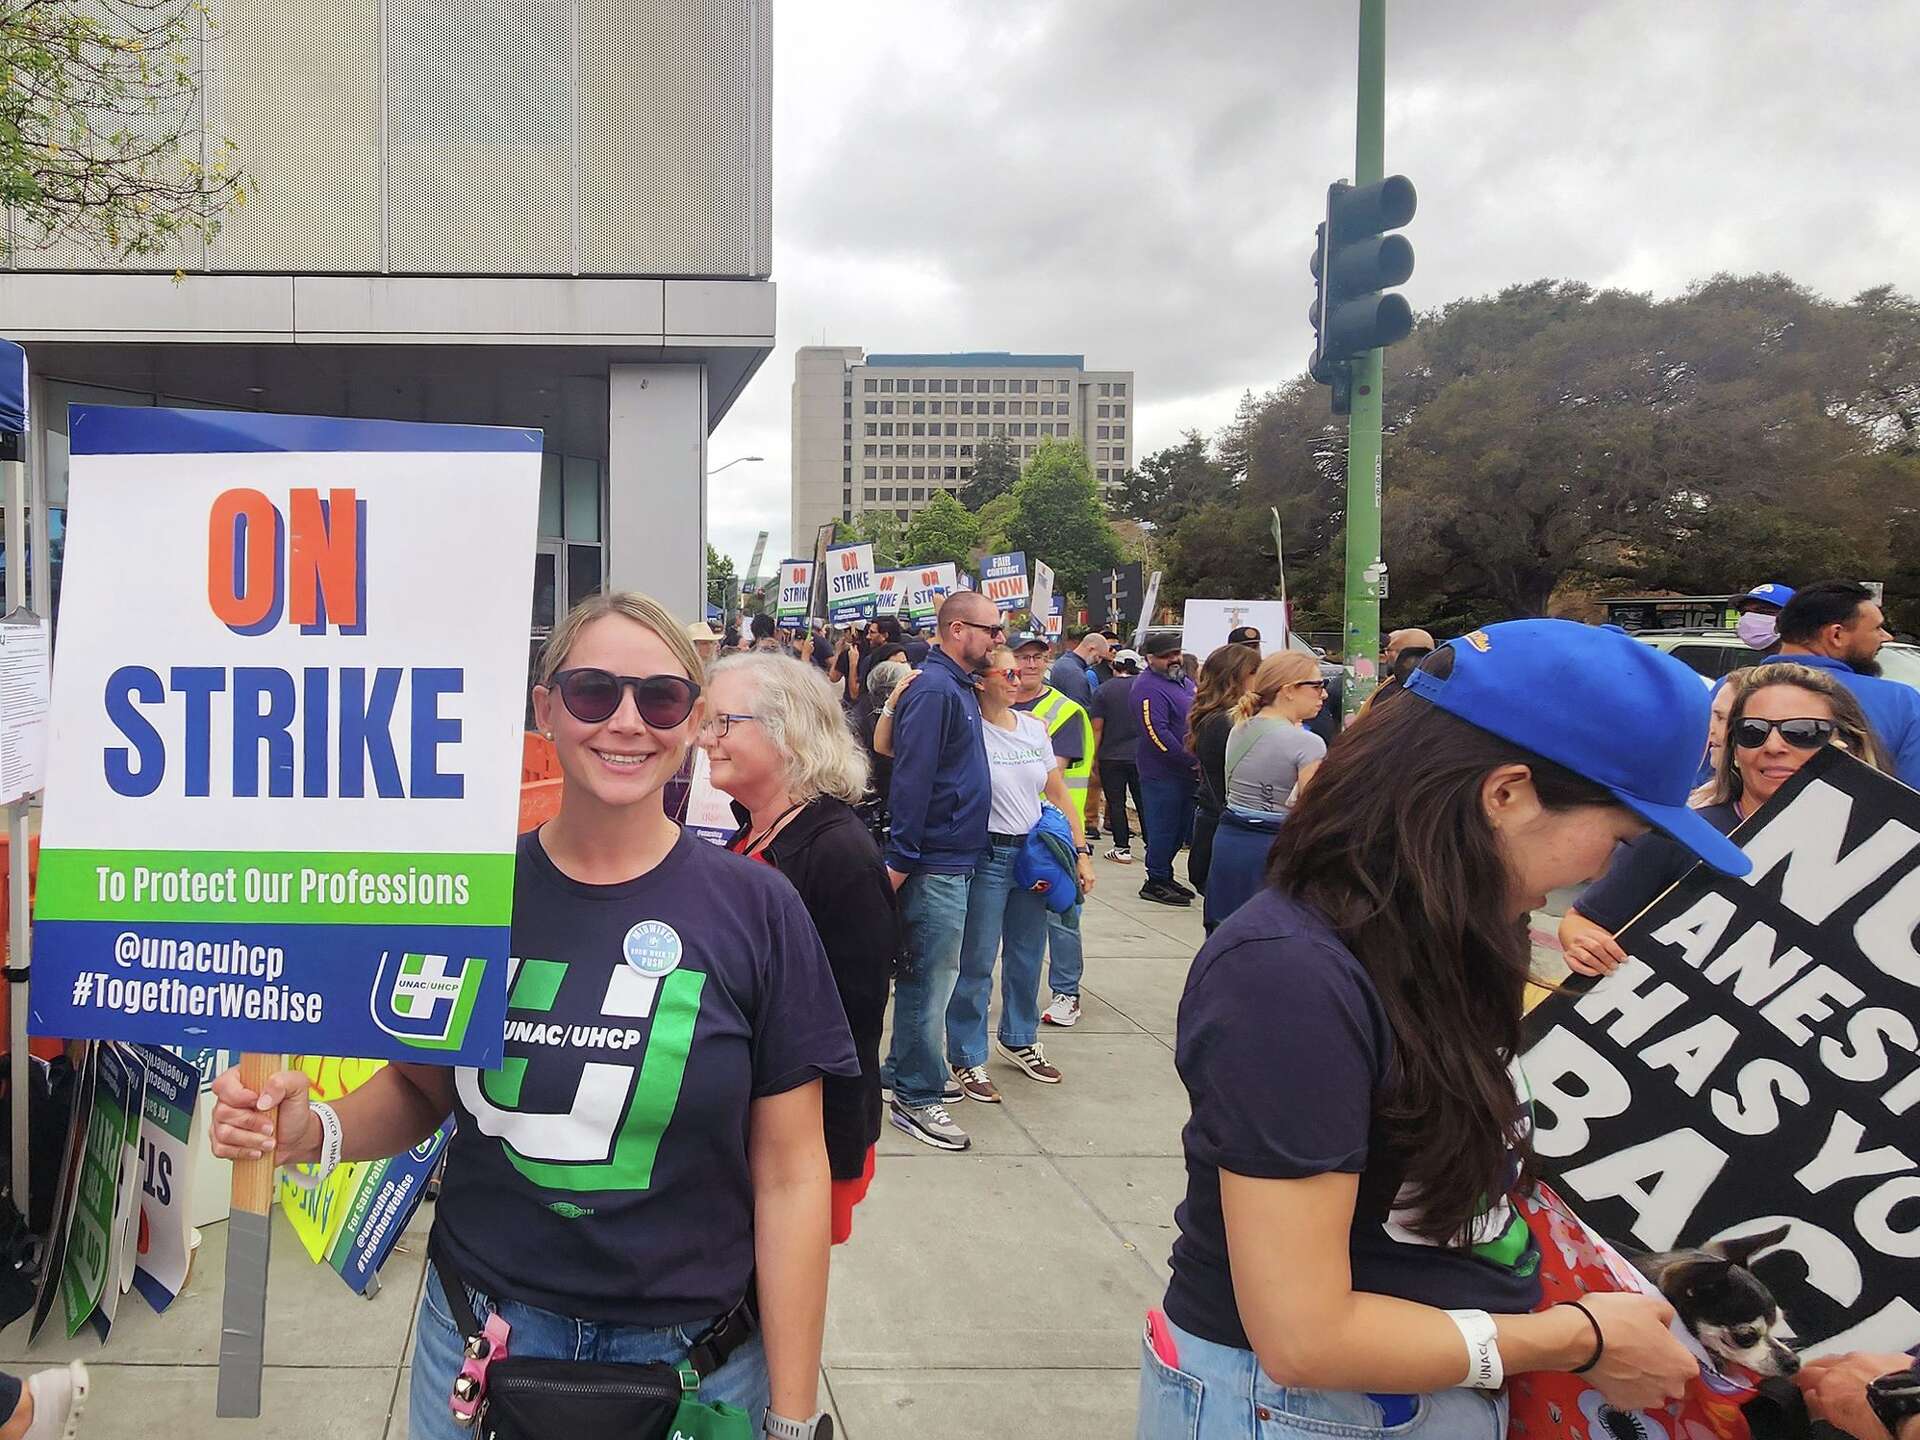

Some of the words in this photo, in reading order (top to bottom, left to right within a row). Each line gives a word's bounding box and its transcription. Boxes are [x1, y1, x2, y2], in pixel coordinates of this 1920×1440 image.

[208, 487, 367, 636] ON
[841, 551, 858, 571] ON
[987, 565, 1019, 577] CONTRACT
[992, 556, 1011, 567] FAIR
[793, 567, 806, 584] ON
[833, 571, 869, 593] STRIKE
[880, 576, 895, 591] ON
[921, 570, 940, 587] ON
[988, 577, 1024, 600] NOW
[783, 587, 808, 602] STRIK
[103, 665, 465, 800] STRIKE
[96, 866, 126, 903] To
[133, 866, 237, 904] Protect
[244, 867, 294, 904] Our
[300, 866, 470, 906] Professions
[114, 931, 285, 983] @unacuhcp
[71, 971, 323, 1024] #TogetherWeRise
[398, 980, 459, 992] UNAC/UHCP
[504, 1020, 641, 1050] UNAC/UHCP
[1573, 954, 1811, 1136] HAS
[348, 1212, 360, 1233] For
[356, 1186, 372, 1213] Safe
[356, 1180, 395, 1248] @unacuhcp
[356, 1173, 414, 1273] #TogetherWeRise
